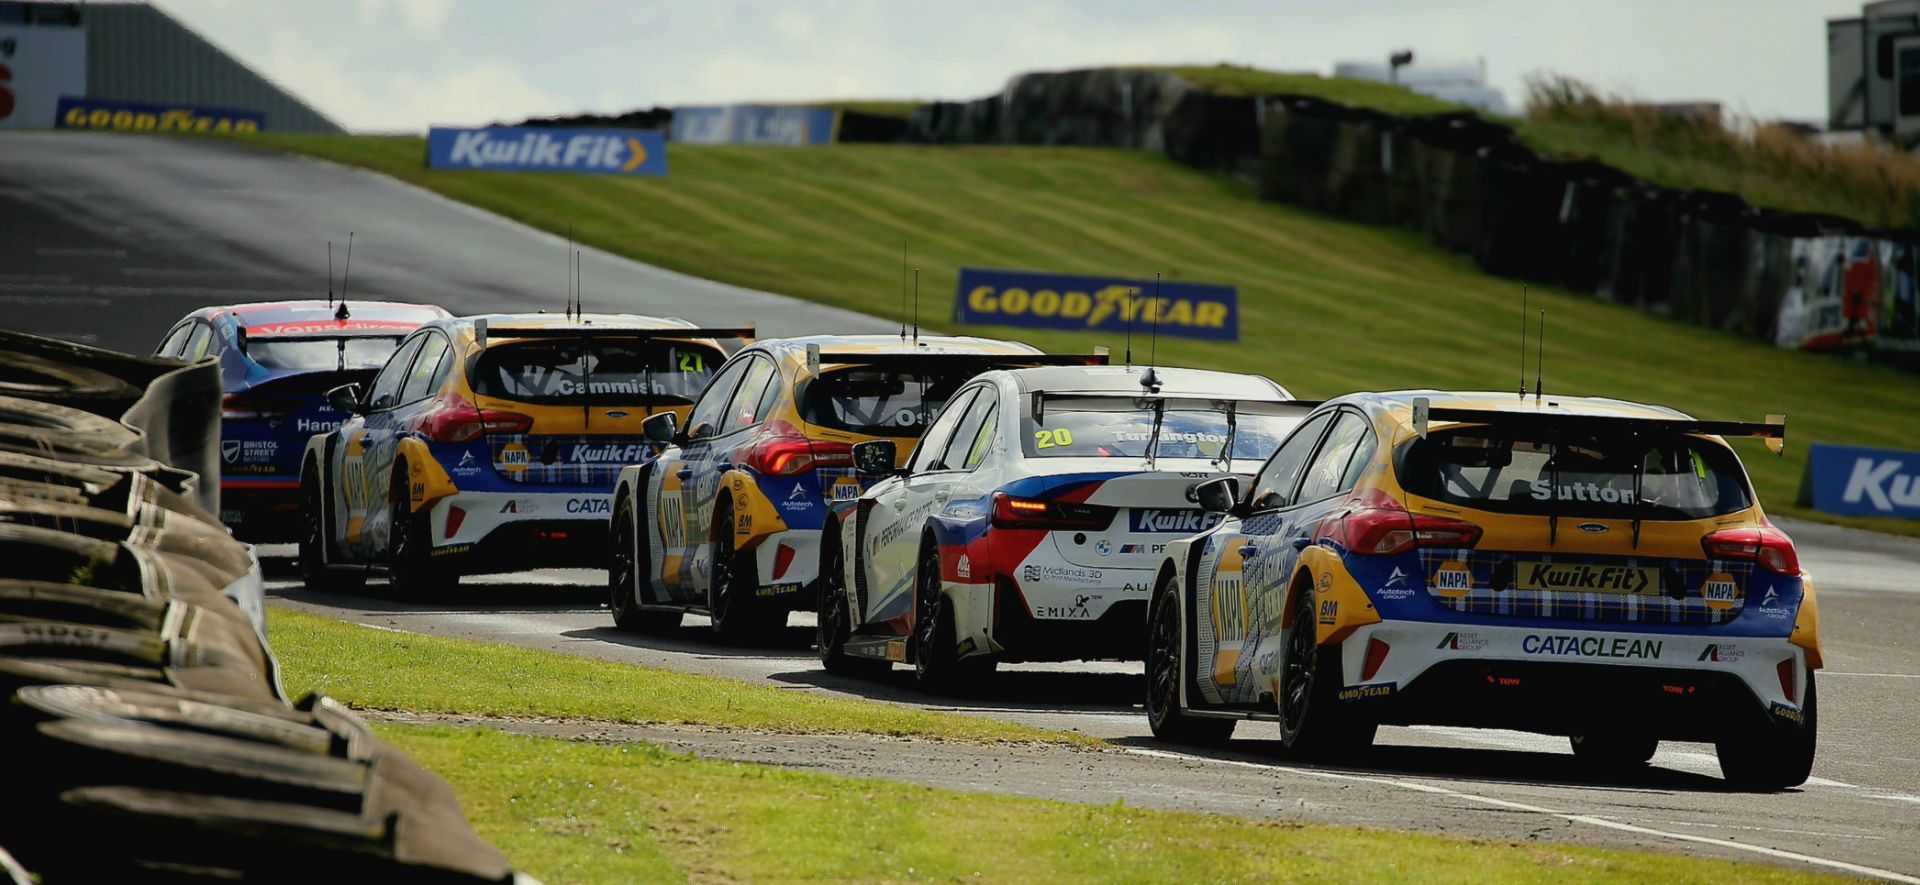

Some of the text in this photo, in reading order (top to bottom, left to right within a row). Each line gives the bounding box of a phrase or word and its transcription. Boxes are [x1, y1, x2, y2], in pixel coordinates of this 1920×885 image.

[968, 284, 1229, 328] GOODYEAR
[676, 352, 704, 373] 27
[558, 379, 667, 396] Cammish
[1035, 428, 1073, 449] 20
[504, 451, 526, 464] NAPA
[836, 485, 859, 499] NAPA
[1529, 479, 1634, 504] Sutton
[782, 500, 813, 508] Autotech
[738, 515, 752, 528] BM
[1042, 566, 1103, 579] Midlands 3D
[1440, 572, 1468, 588] NAPA
[1376, 588, 1416, 596] Autotech
[1707, 583, 1734, 599] NAPA
[1320, 601, 1338, 616] BM
[1522, 634, 1664, 659] CATACLEAN
[1499, 678, 1521, 686] TOW
[1663, 685, 1684, 694] TOW
[1339, 685, 1391, 700] GOODYEAR
